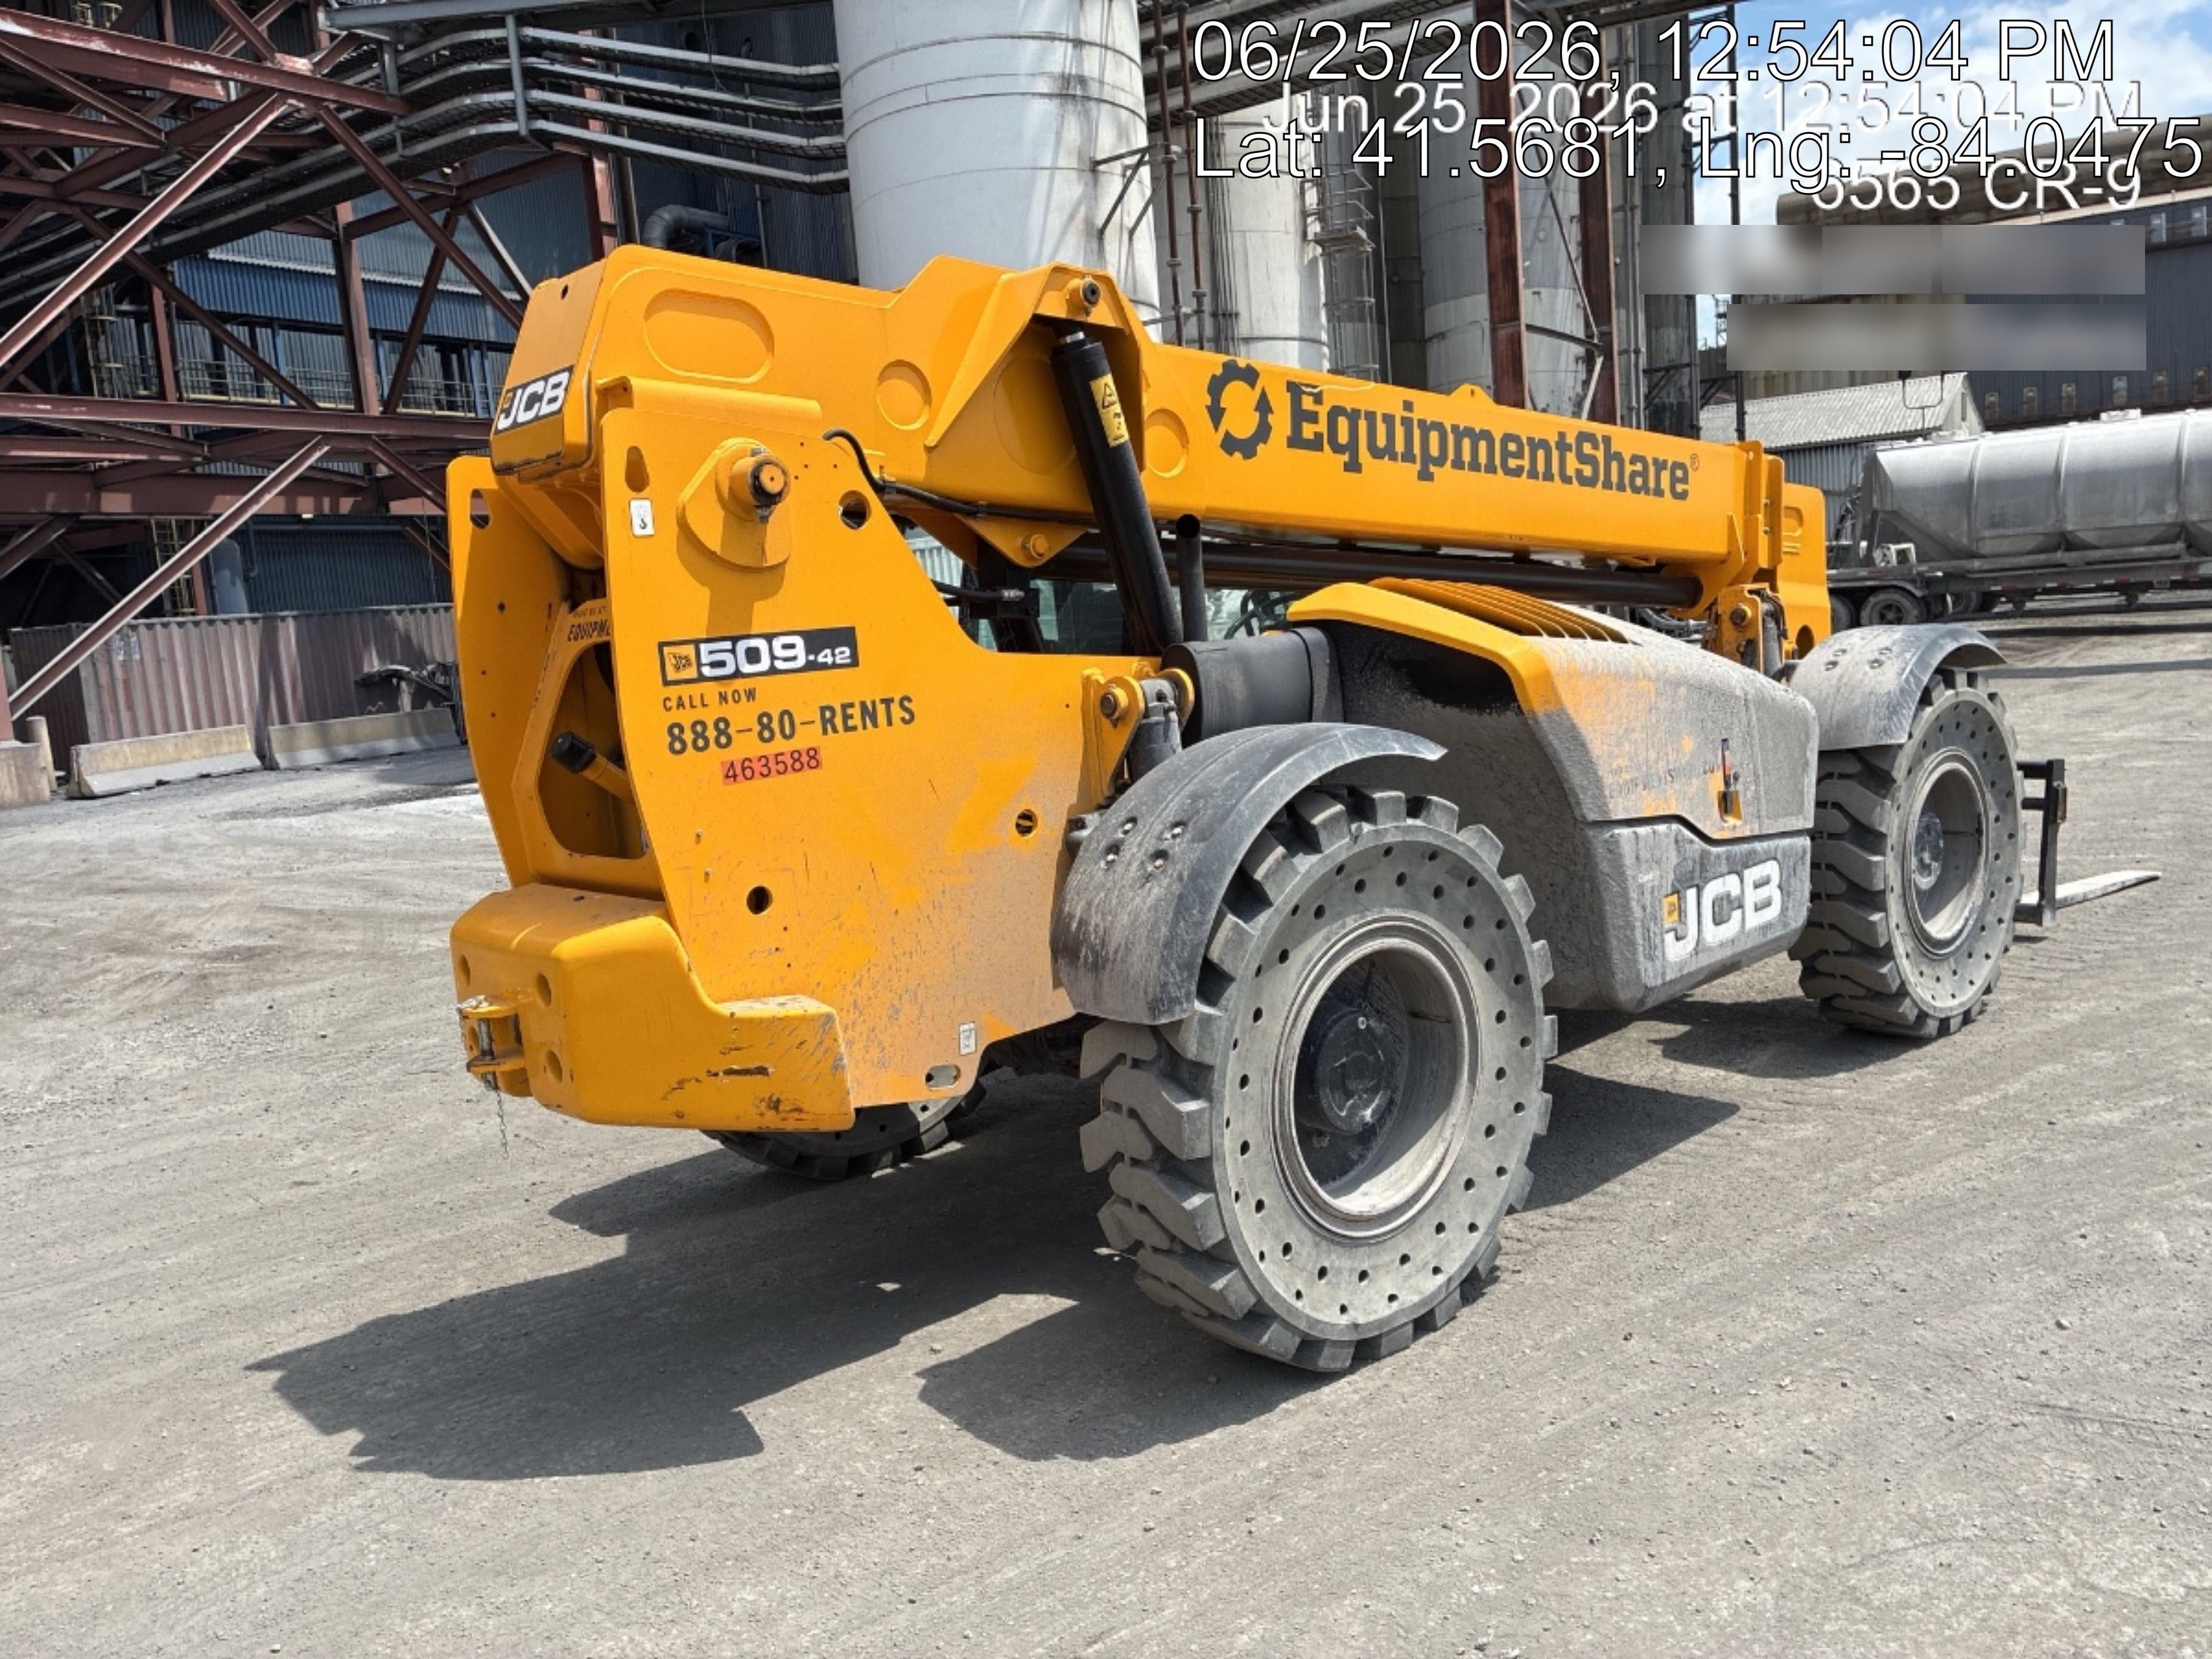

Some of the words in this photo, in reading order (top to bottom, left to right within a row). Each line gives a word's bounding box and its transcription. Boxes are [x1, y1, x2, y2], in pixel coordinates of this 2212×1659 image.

[496, 371, 570, 430] JCB
[662, 692, 710, 712] CALL
[718, 687, 758, 706] NOW
[666, 694, 916, 756] 888-80-RENTS
[723, 747, 820, 783] 463588
[1663, 860, 1783, 963] JCB
